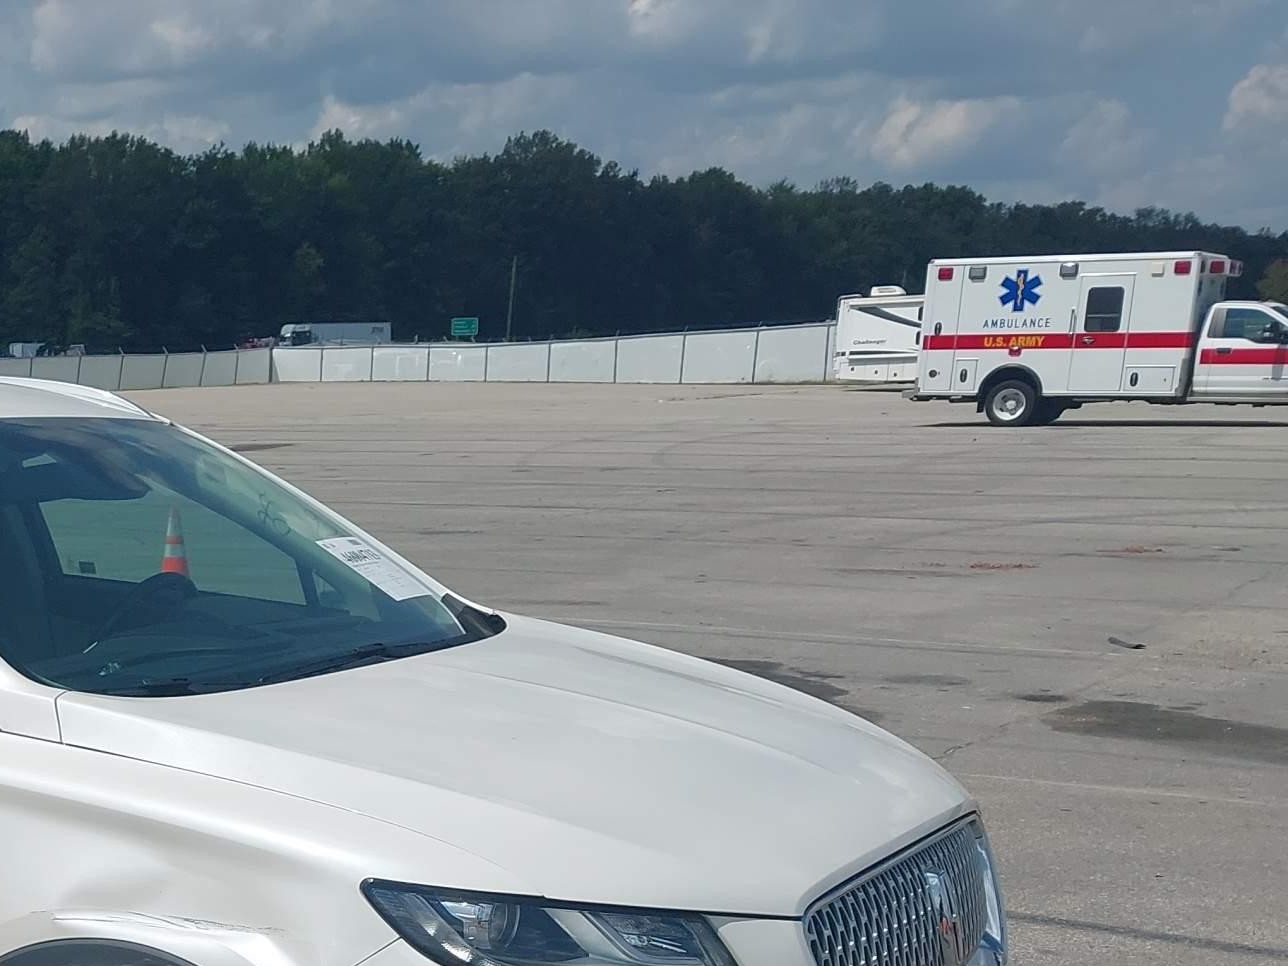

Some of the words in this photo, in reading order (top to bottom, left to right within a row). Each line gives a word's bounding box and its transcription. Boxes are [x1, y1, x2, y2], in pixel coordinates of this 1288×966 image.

[982, 318, 1051, 328] AMBULANCE
[983, 336, 1007, 347] U.S.
[1009, 336, 1045, 347] ARMY
